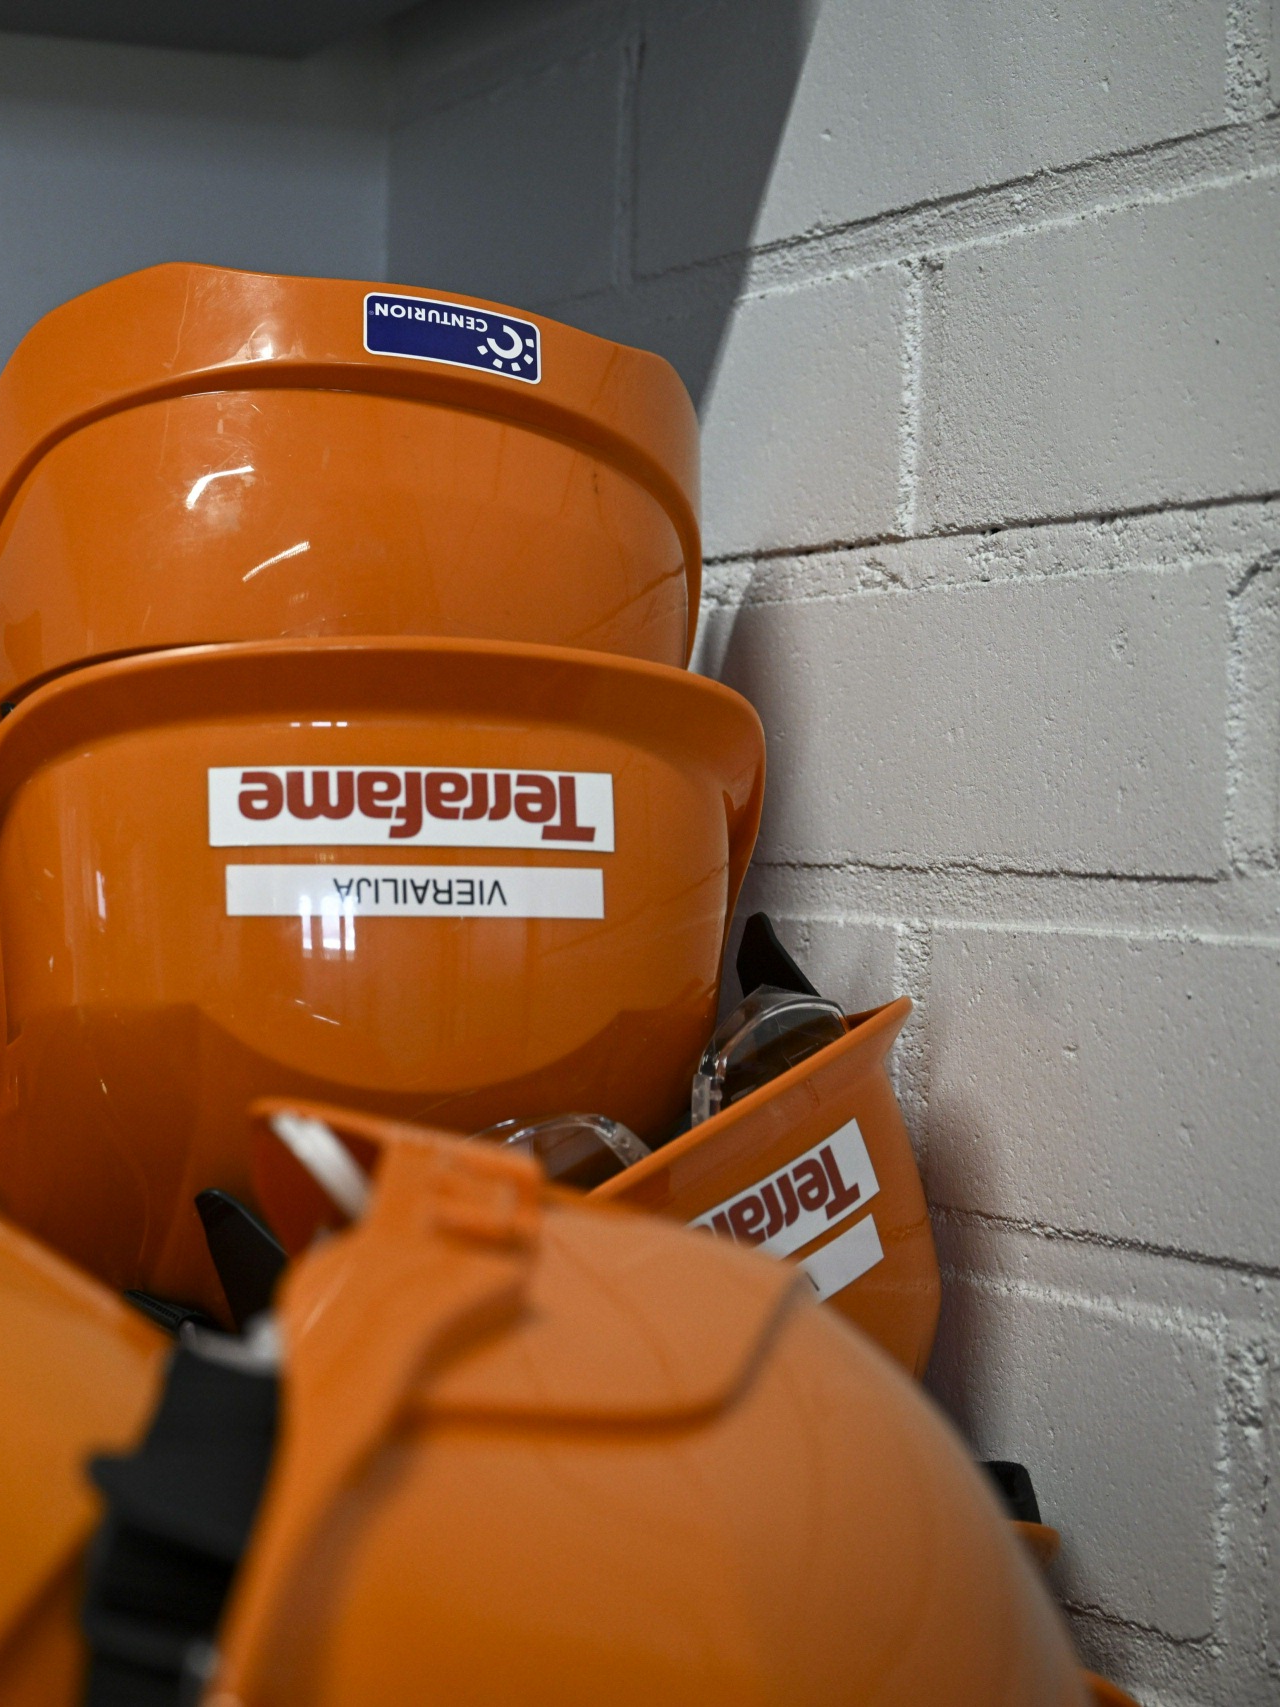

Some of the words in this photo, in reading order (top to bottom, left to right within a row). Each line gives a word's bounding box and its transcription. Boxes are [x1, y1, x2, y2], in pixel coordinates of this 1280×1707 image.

[374, 301, 489, 333] CENTURION
[237, 770, 596, 842] Terrafame
[332, 877, 508, 906] VIERAILIJA
[694, 1144, 862, 1248] Terra
